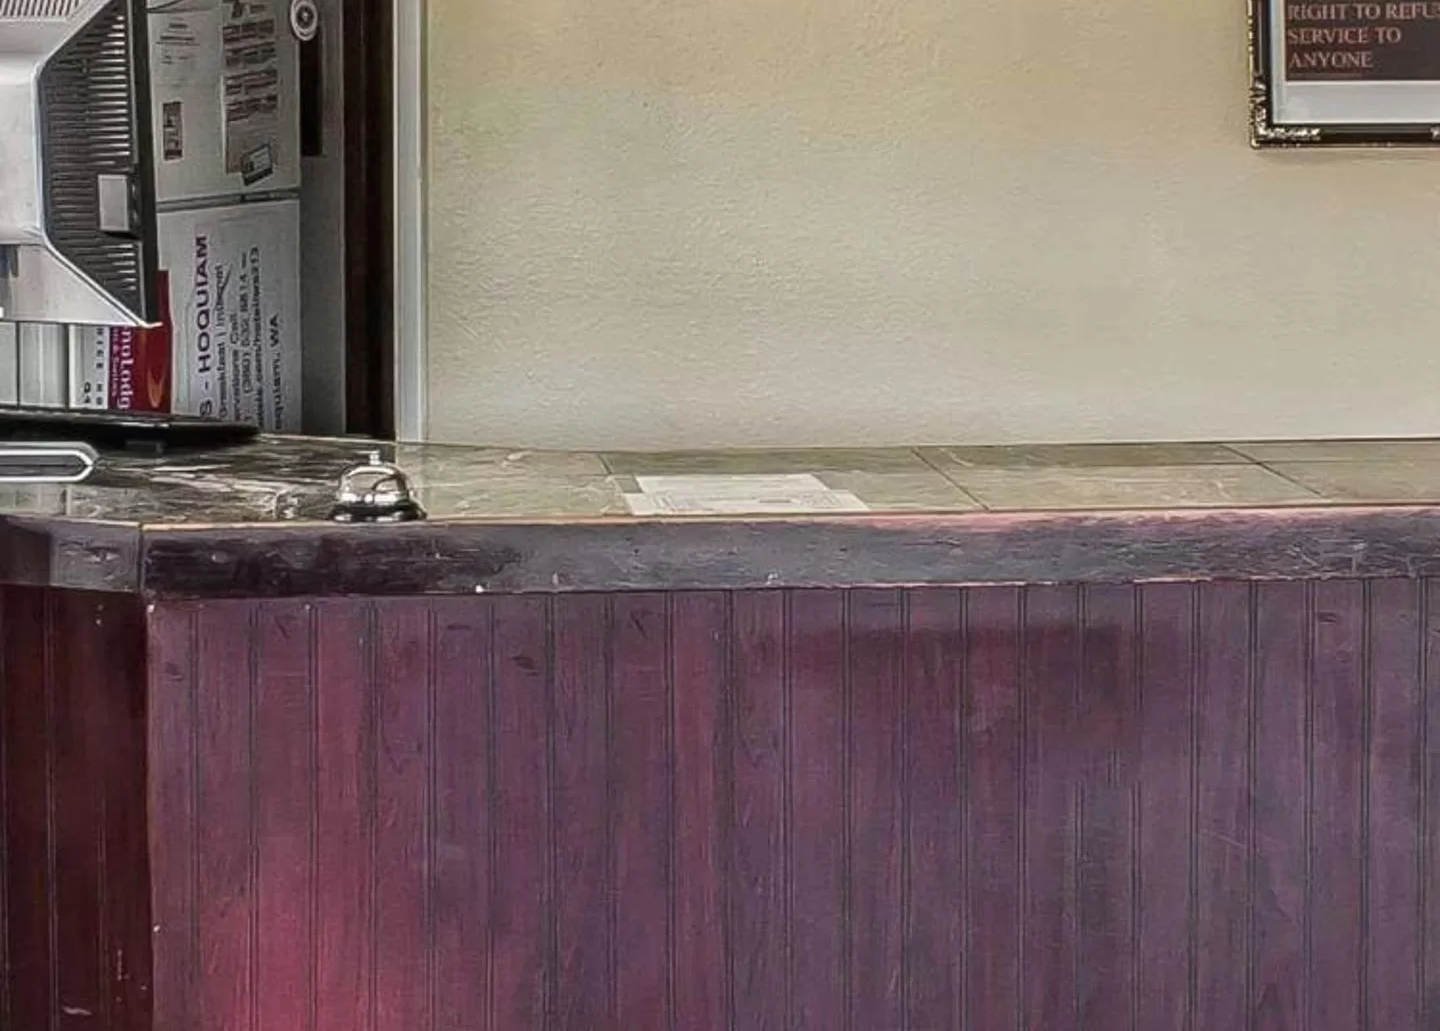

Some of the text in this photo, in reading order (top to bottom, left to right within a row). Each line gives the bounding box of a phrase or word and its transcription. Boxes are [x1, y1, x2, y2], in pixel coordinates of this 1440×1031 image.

[1288, 3, 1349, 20] RIGHT
[1355, 3, 1380, 19] TO
[1288, 27, 1401, 44] SERVICE TO
[1288, 51, 1373, 68] ANYONE
[195, 236, 212, 373] HOQUIAM
[269, 312, 284, 430] oquiam, WA
